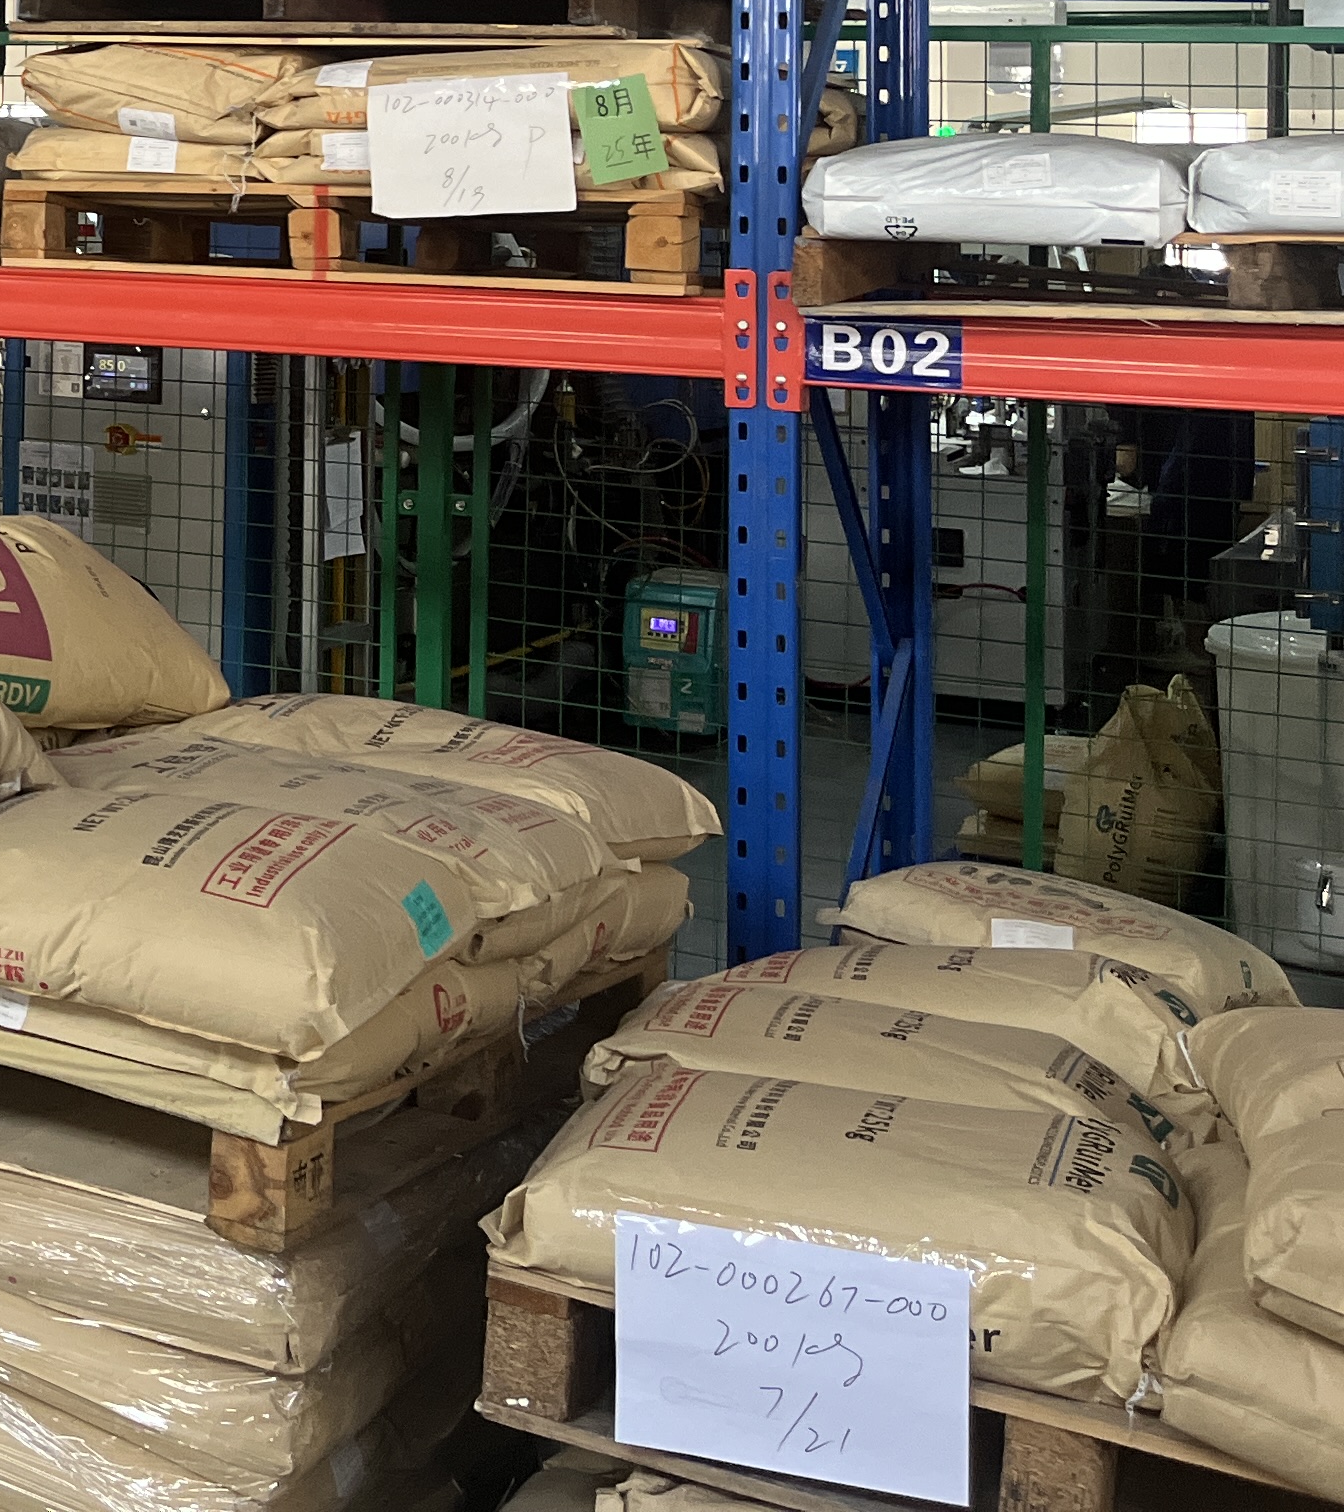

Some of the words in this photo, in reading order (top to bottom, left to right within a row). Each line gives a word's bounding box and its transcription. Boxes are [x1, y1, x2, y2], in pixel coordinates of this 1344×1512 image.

[596, 88, 633, 118] 8月
[98, 359, 127, 372] 850
[819, 324, 952, 379] B02
[1064, 1115, 1122, 1194] lyGRuiMer
[629, 1232, 950, 1325] 102-000267-000
[759, 1386, 853, 1455] 7/21
